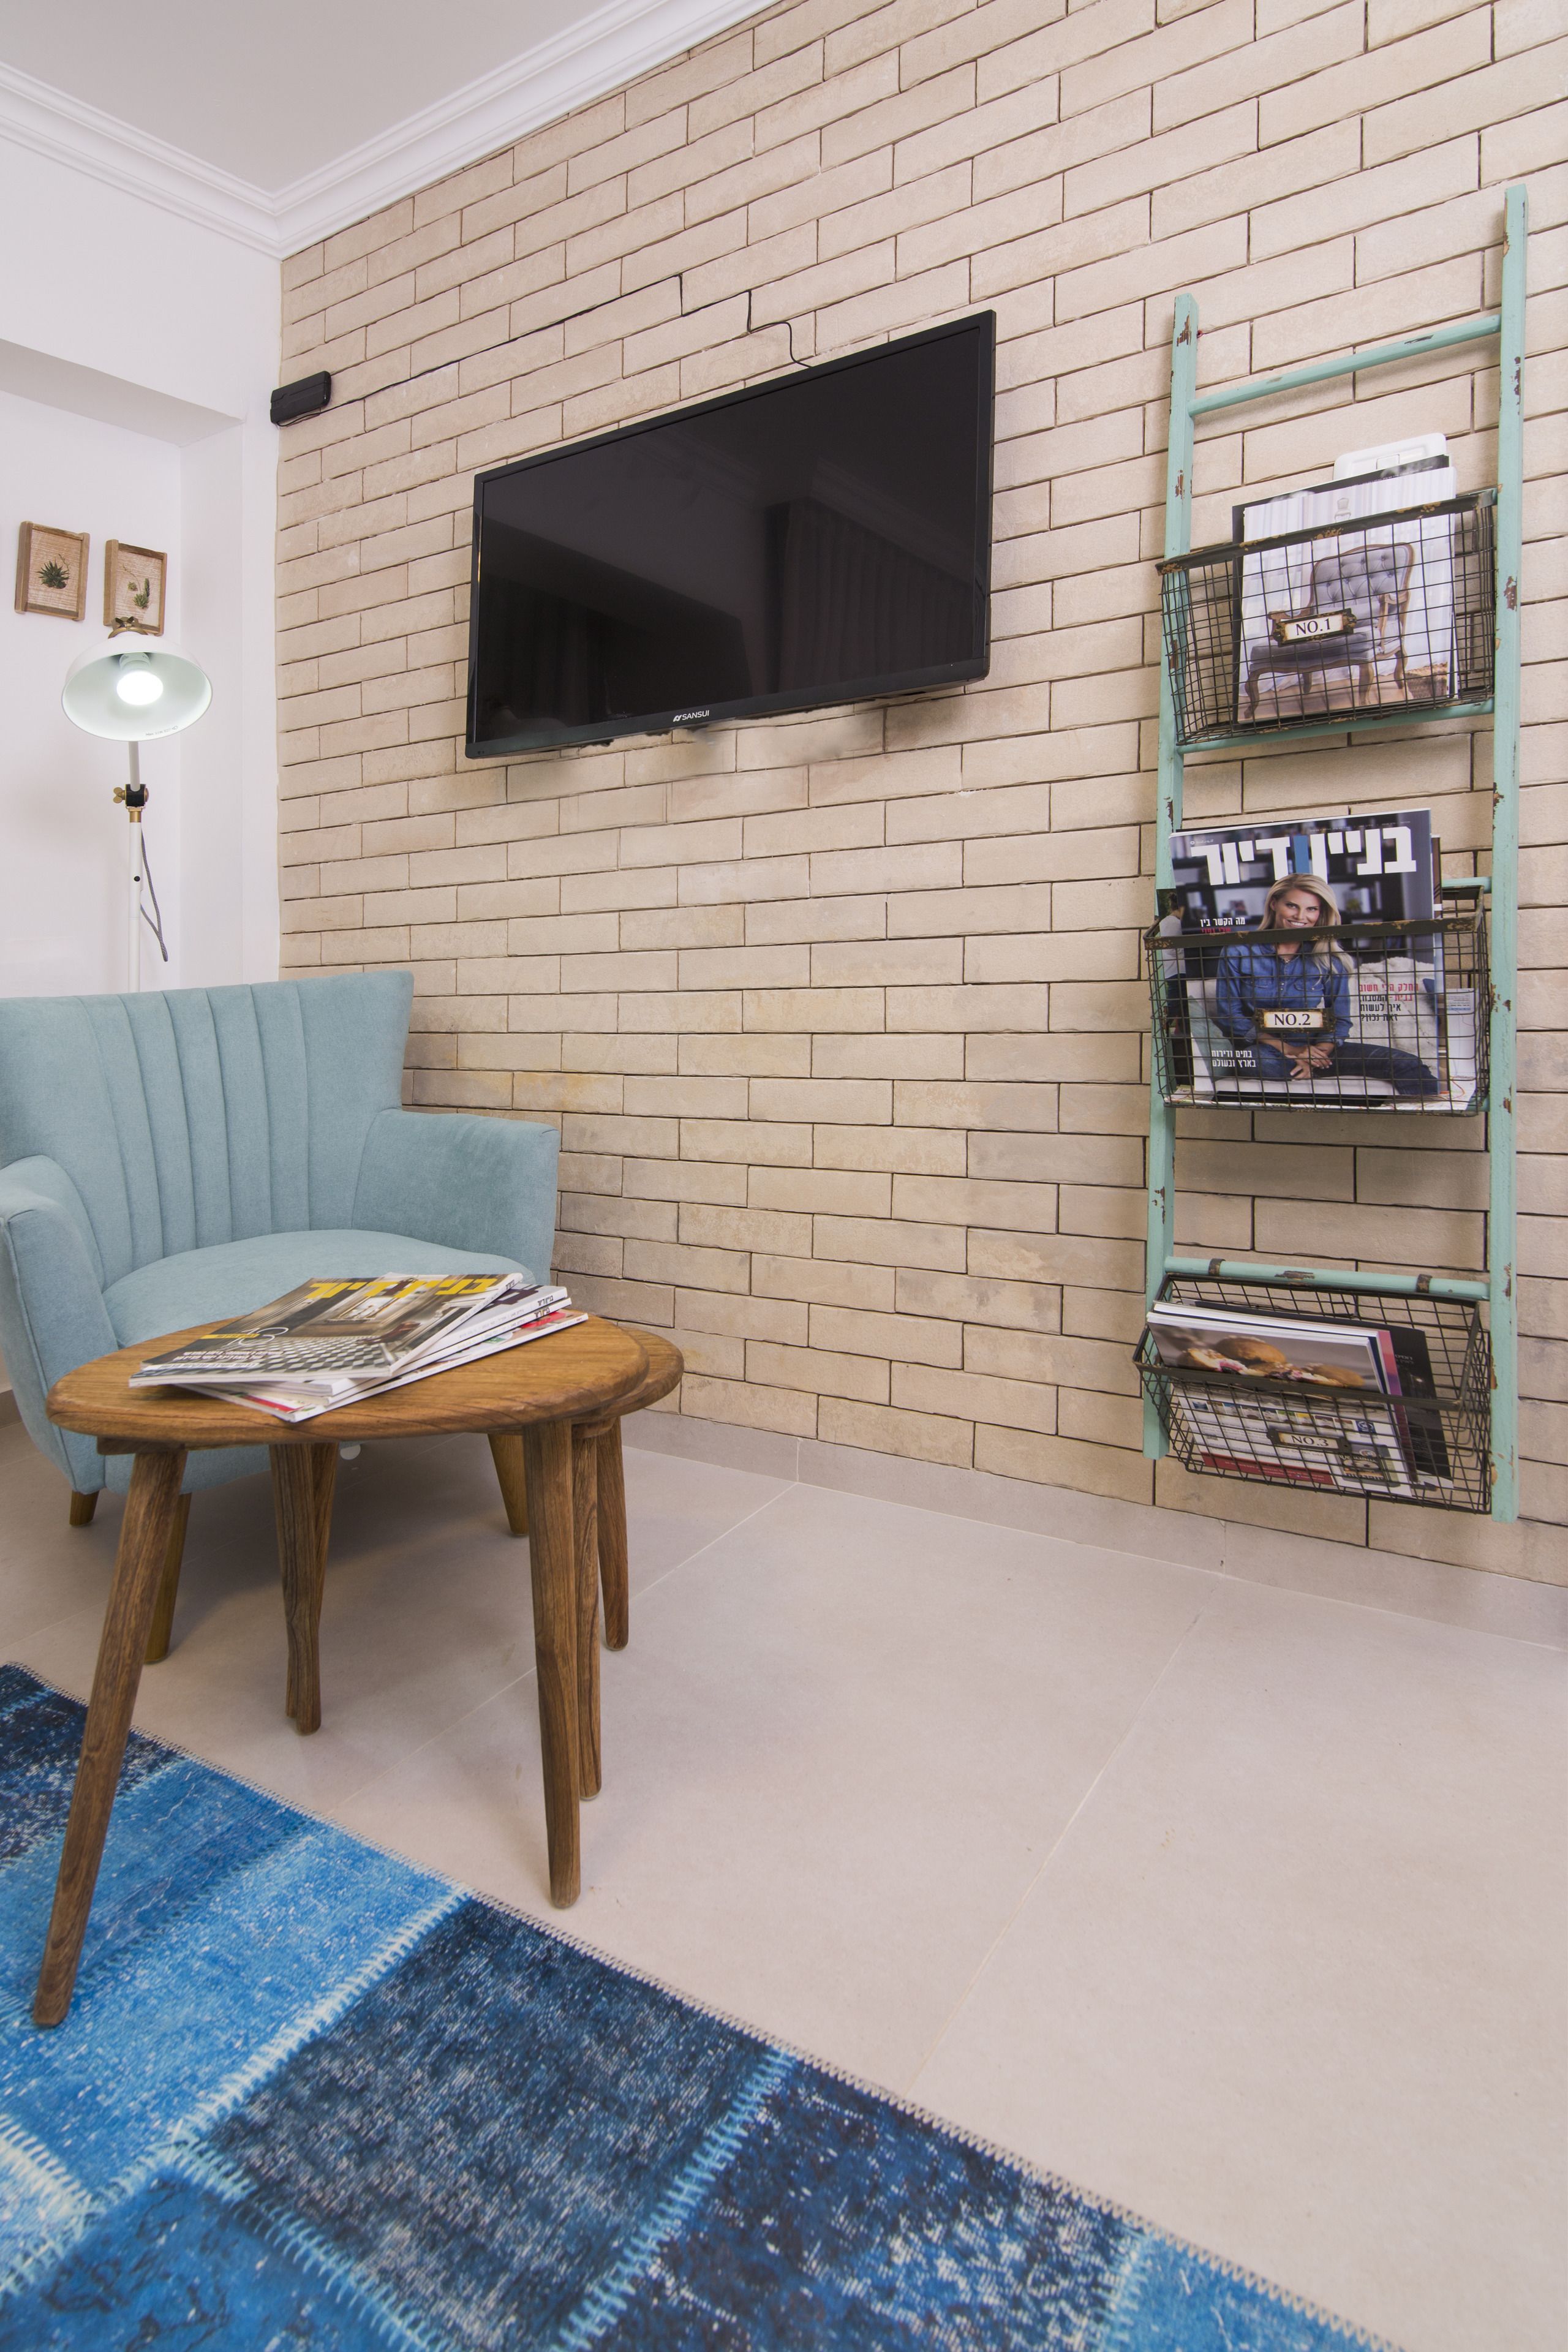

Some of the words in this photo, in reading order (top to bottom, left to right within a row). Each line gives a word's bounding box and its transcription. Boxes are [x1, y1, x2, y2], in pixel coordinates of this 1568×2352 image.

[1295, 618, 1330, 636] NO.1
[682, 710, 709, 721] SANSUI
[1200, 919, 1211, 927] בין
[1213, 918, 1233, 926] הקשר
[1235, 917, 1246, 925] מה
[1360, 1003, 1384, 1011] לעשות
[1387, 1003, 1401, 1012] איך
[1274, 1013, 1311, 1026] NO.2
[1212, 1058, 1235, 1067] ובעולם
[1291, 1435, 1329, 1447] NO.3
